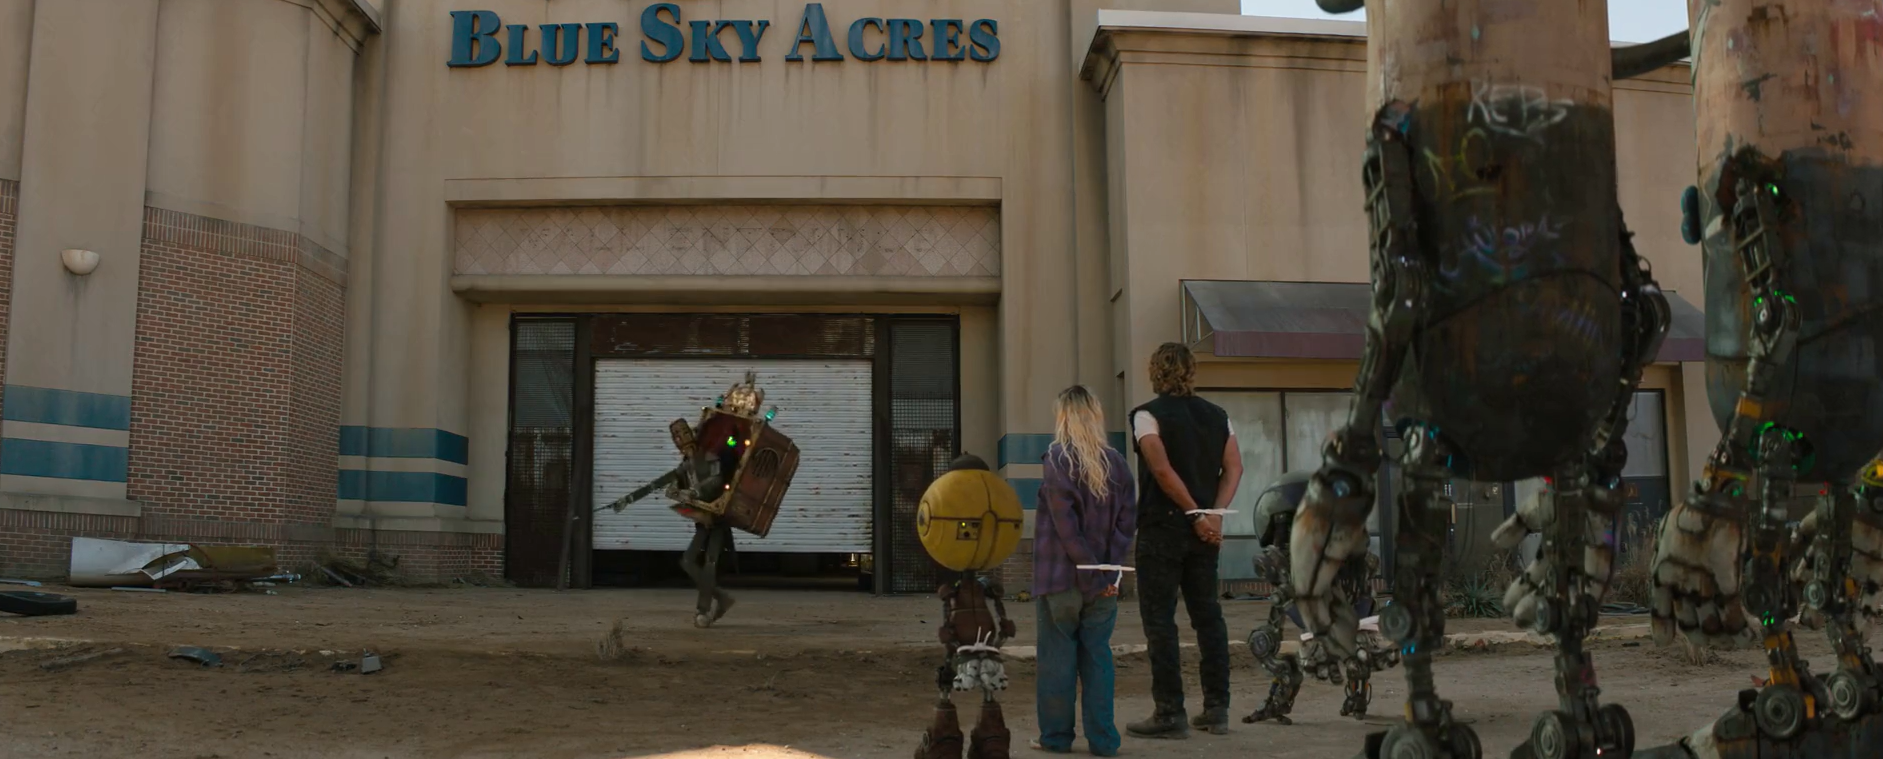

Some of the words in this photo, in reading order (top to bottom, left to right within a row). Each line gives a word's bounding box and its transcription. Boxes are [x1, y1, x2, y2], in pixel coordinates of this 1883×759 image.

[447, 10, 619, 67] BLUE
[640, 3, 770, 62] SKY
[785, 3, 1001, 62] ACRES
